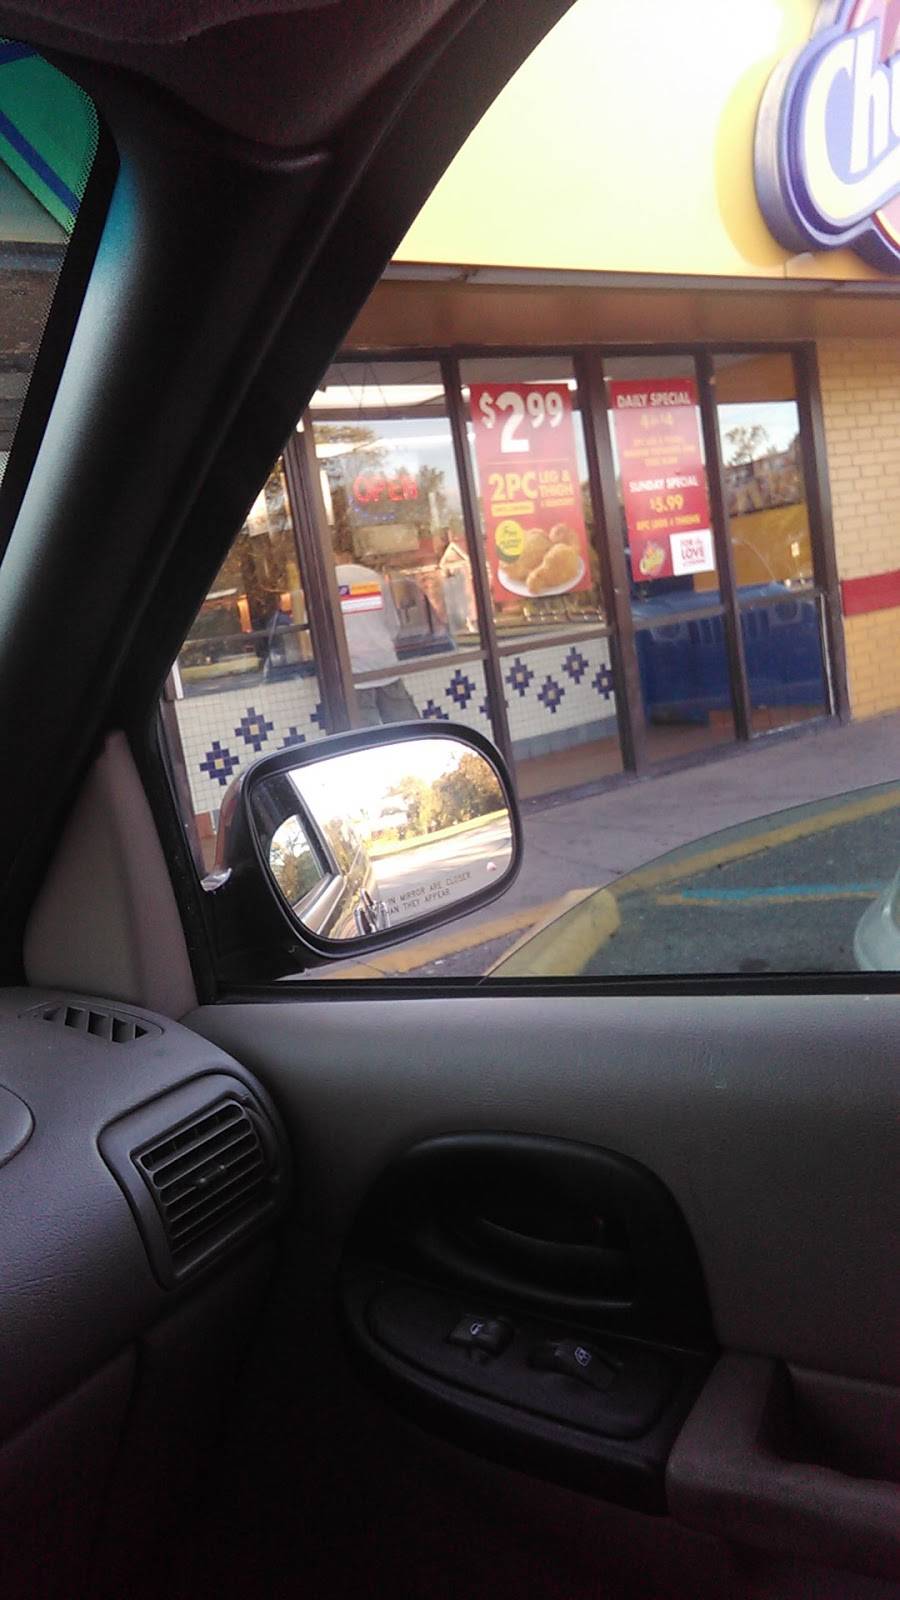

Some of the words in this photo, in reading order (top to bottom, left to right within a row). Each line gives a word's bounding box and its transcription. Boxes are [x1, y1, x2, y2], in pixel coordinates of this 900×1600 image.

[616, 394, 648, 408] DAILY
[649, 391, 691, 407] SPECIAL
[353, 473, 418, 503] OPEN
[488, 471, 538, 501] 2PC
[629, 479, 665, 493] SUNDAY
[666, 476, 698, 489] SPECIAL
[681, 547, 705, 560] LOVE
[400, 887, 425, 900] MIRROR
[430, 881, 442, 891] ARE
[446, 872, 470, 886] CLOSER
[403, 898, 420, 910] THEY
[425, 889, 449, 901] APPEAR
